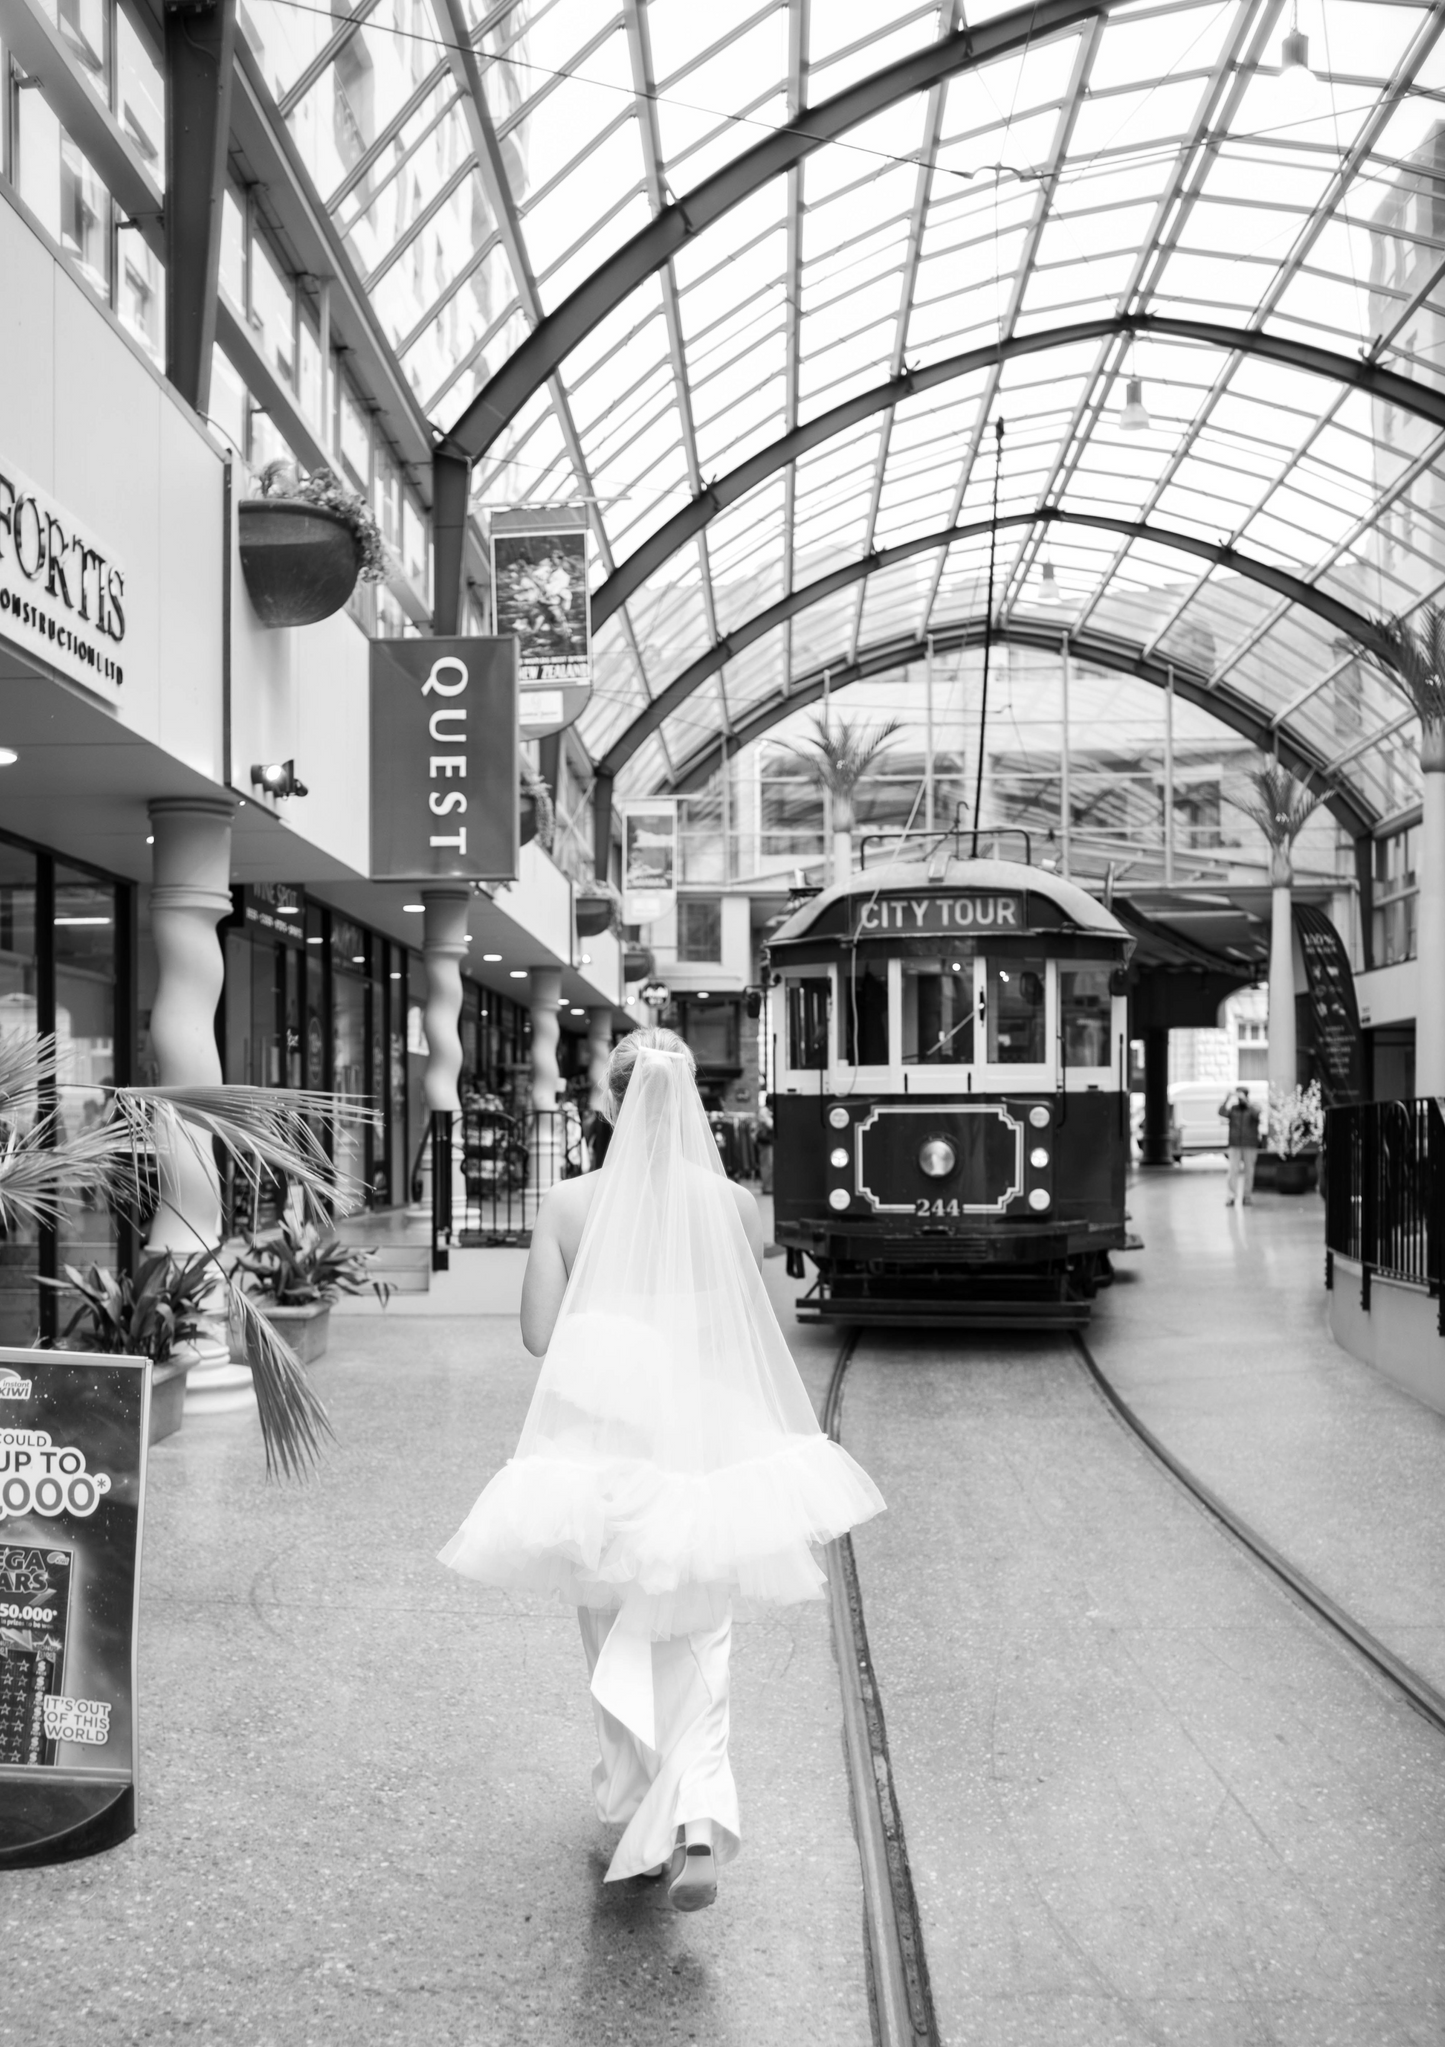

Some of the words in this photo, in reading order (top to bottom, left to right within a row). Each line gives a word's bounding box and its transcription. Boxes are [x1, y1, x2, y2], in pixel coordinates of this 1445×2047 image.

[420, 656, 469, 855] QUEST
[860, 900, 929, 929] CITY
[936, 898, 1017, 927] TOUR
[916, 1198, 961, 1217] 244
[0, 1433, 47, 1448] OULD
[40, 1452, 81, 1475] TO
[46, 1697, 73, 1712] IT'S
[77, 1701, 109, 1717] OUT
[46, 1711, 69, 1724] OF
[73, 1714, 108, 1730] THIS
[46, 1723, 106, 1742] WORLD
